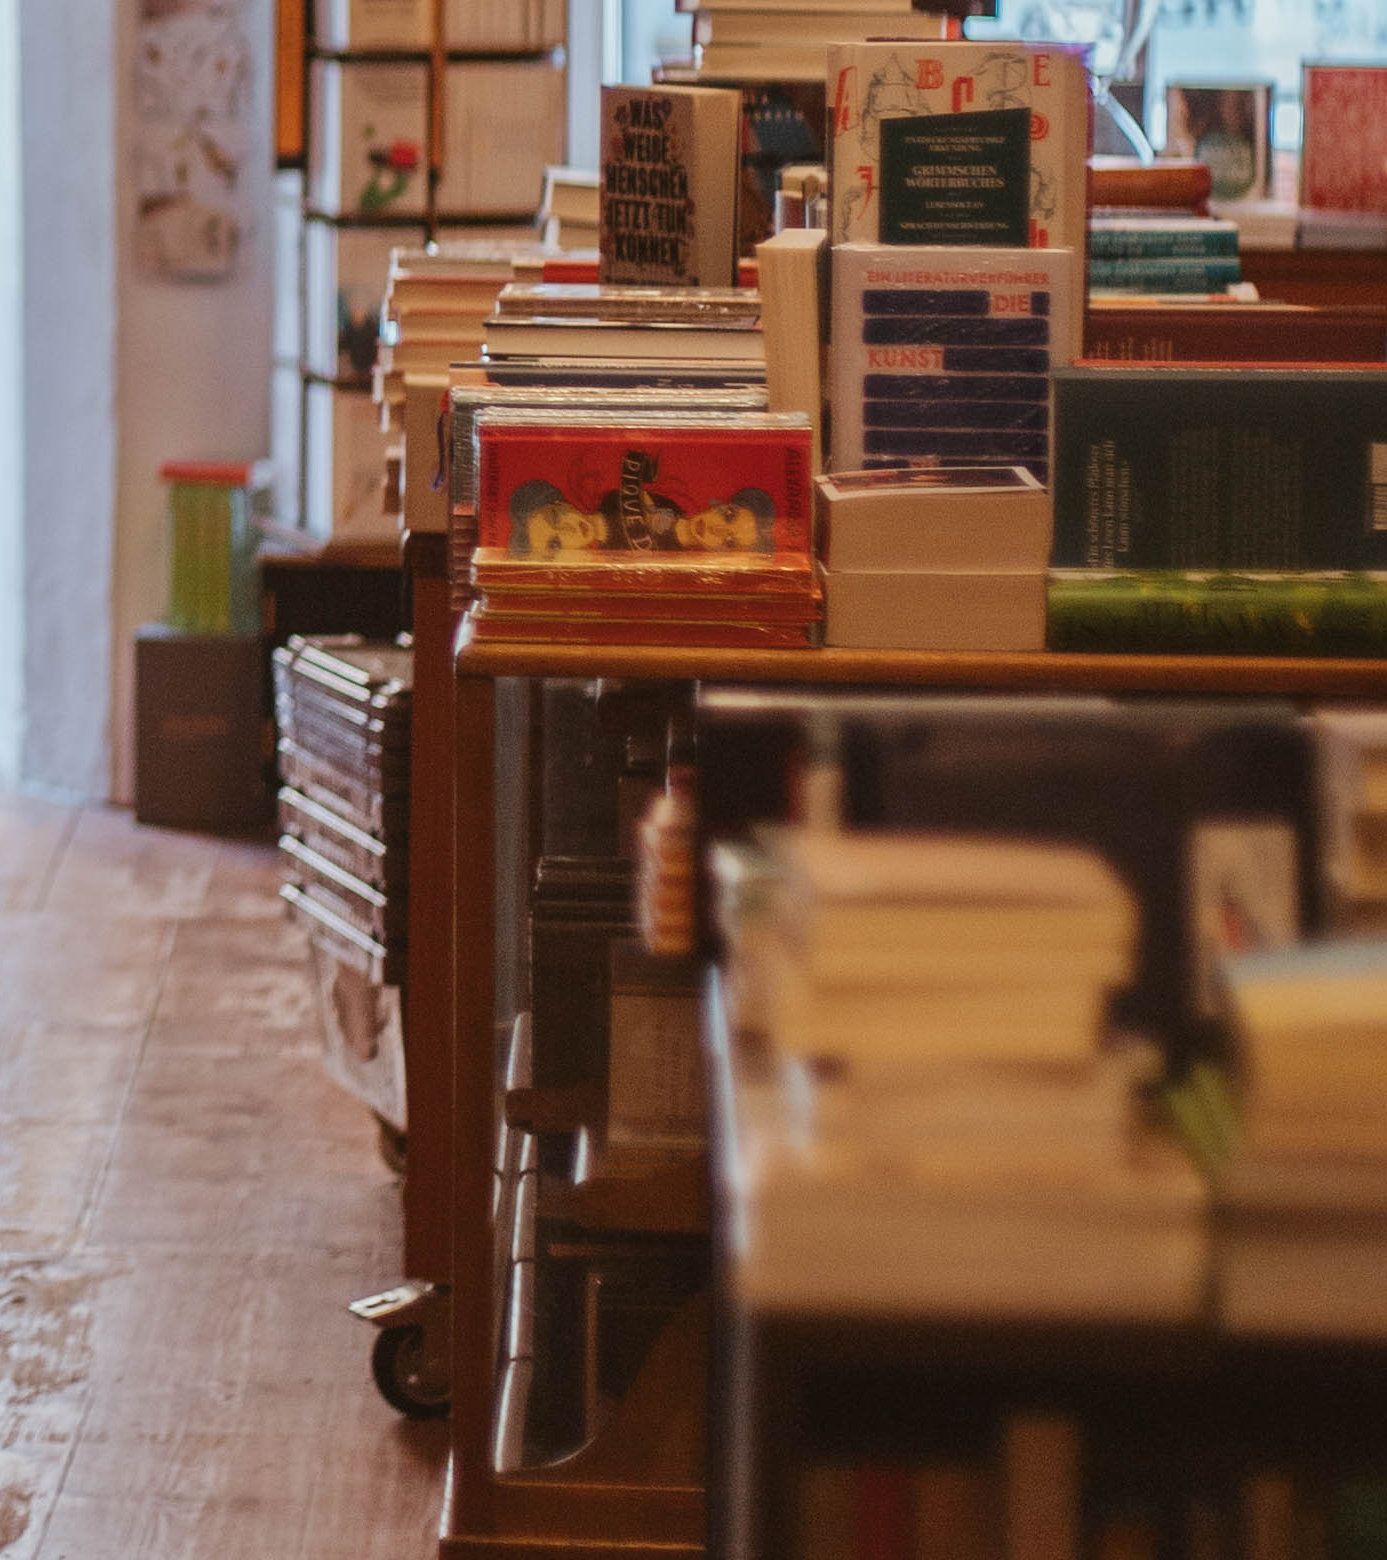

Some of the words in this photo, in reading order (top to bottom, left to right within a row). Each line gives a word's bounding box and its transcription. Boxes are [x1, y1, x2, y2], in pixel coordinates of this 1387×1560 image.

[606, 164, 688, 197] MENSCHEN
[911, 164, 998, 178] GRIMMSCHEN
[904, 176, 1005, 190] WÖRTERBUCHES
[606, 198, 650, 229] JETZT
[993, 293, 1031, 313] DIE
[867, 348, 944, 369] KUNST
